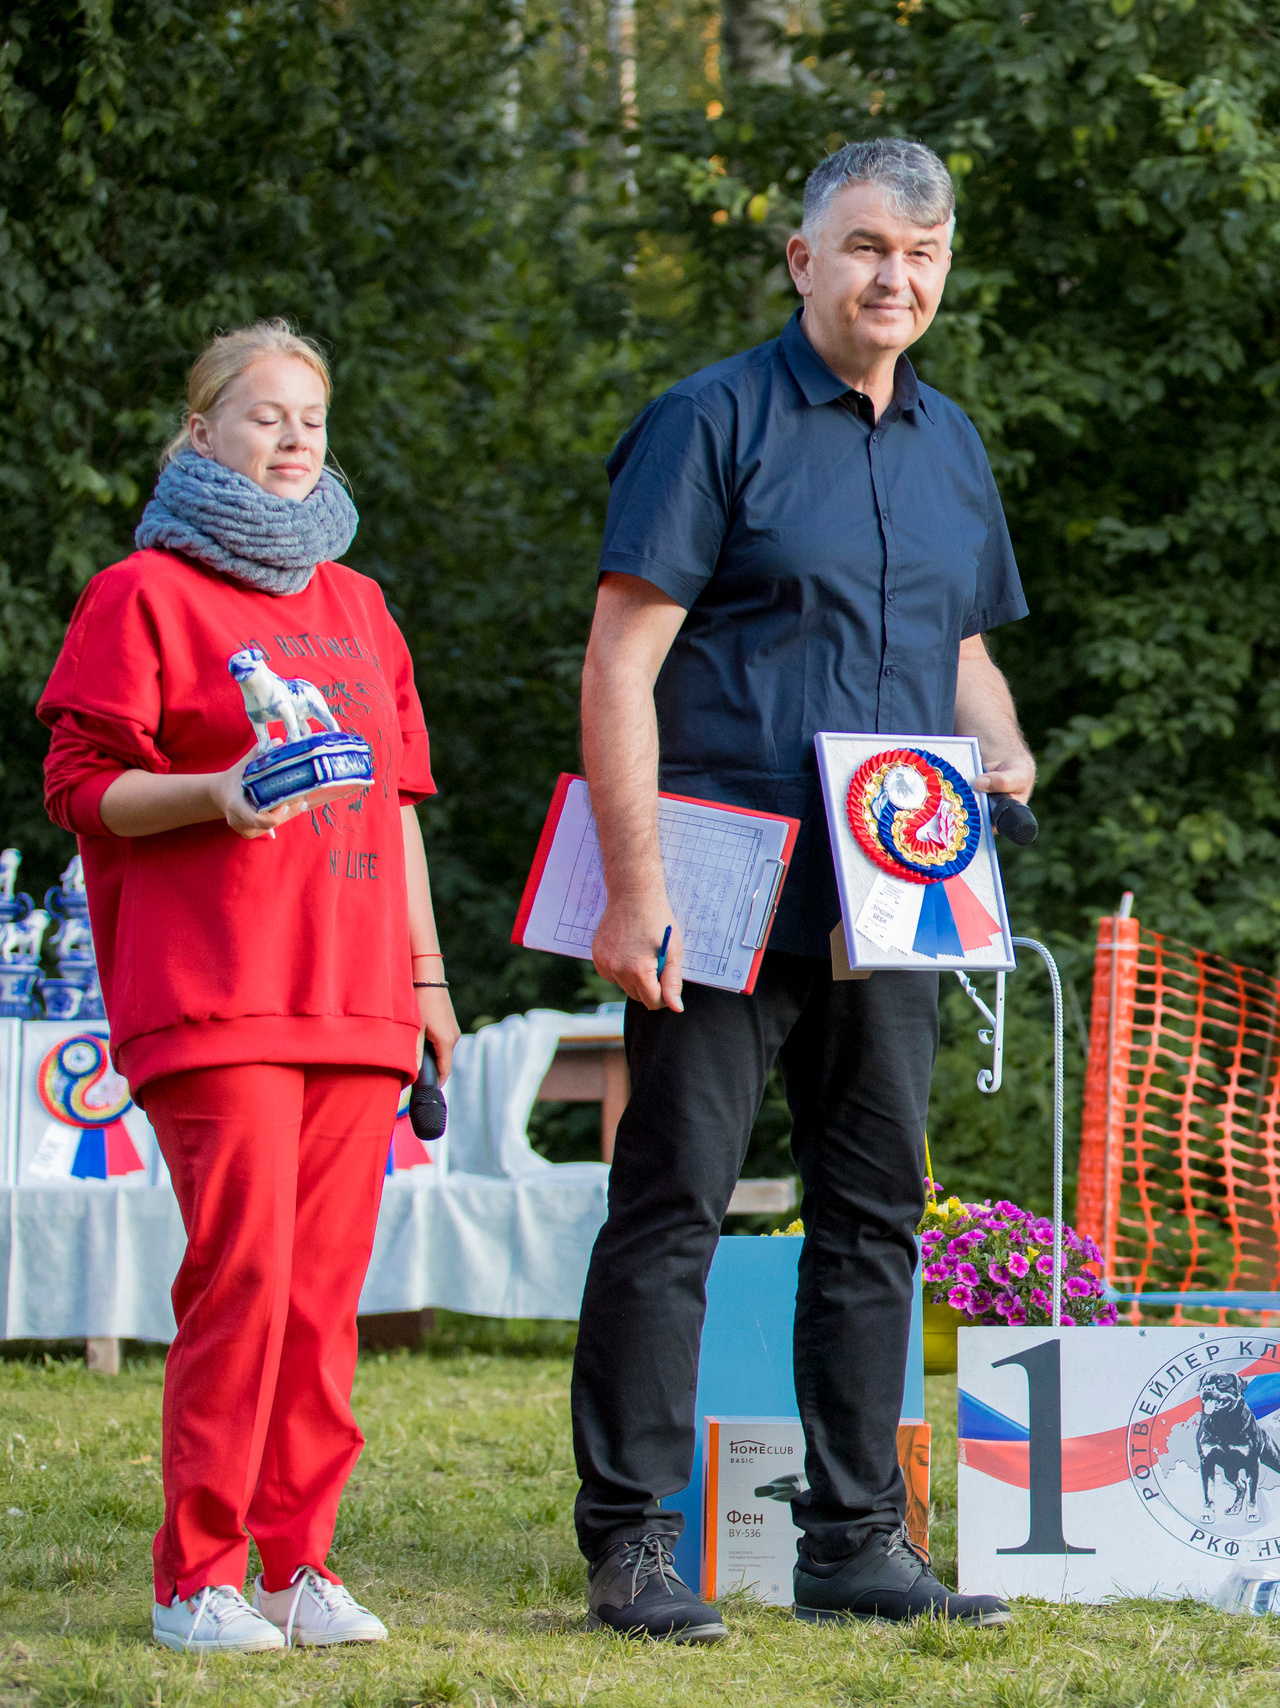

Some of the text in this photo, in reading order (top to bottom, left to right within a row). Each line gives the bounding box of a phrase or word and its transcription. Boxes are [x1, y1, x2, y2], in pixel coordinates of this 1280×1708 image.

[346, 851, 378, 880] LIFE
[1131, 1345, 1220, 1501] РОТВЕЙЛЕР
[730, 1442, 794, 1455] HOMECLUB
[991, 1339, 1096, 1554] 1
[726, 1510, 764, 1525] Фен
[728, 1528, 762, 1538] BY-536
